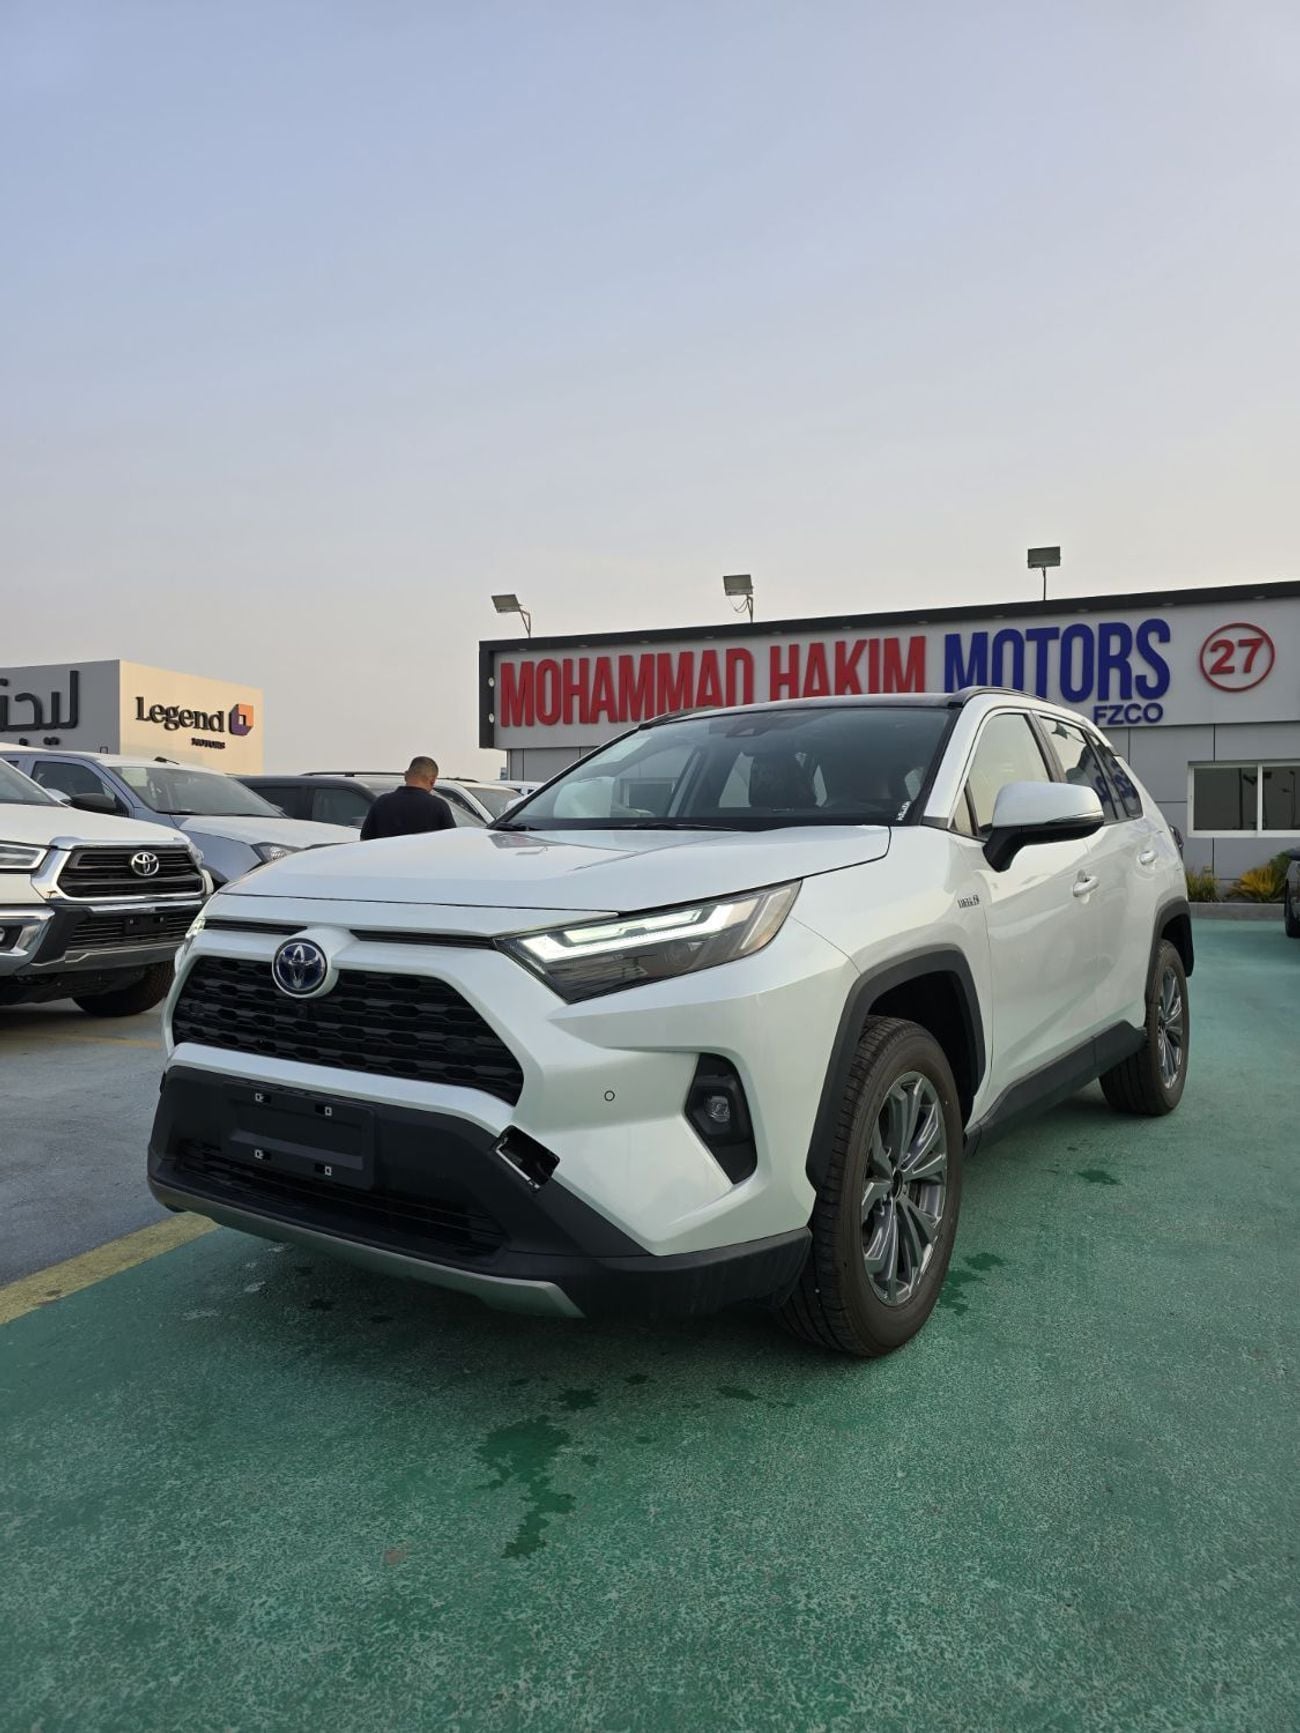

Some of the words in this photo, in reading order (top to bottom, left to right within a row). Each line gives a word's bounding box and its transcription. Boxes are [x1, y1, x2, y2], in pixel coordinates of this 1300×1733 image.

[500, 648, 754, 727] MOHAMMAD
[769, 636, 926, 703] HAKIM
[944, 618, 1171, 703] MOTORS
[1208, 637, 1265, 676] 27
[135, 696, 225, 731] Legend
[1093, 702, 1164, 726] FZCO
